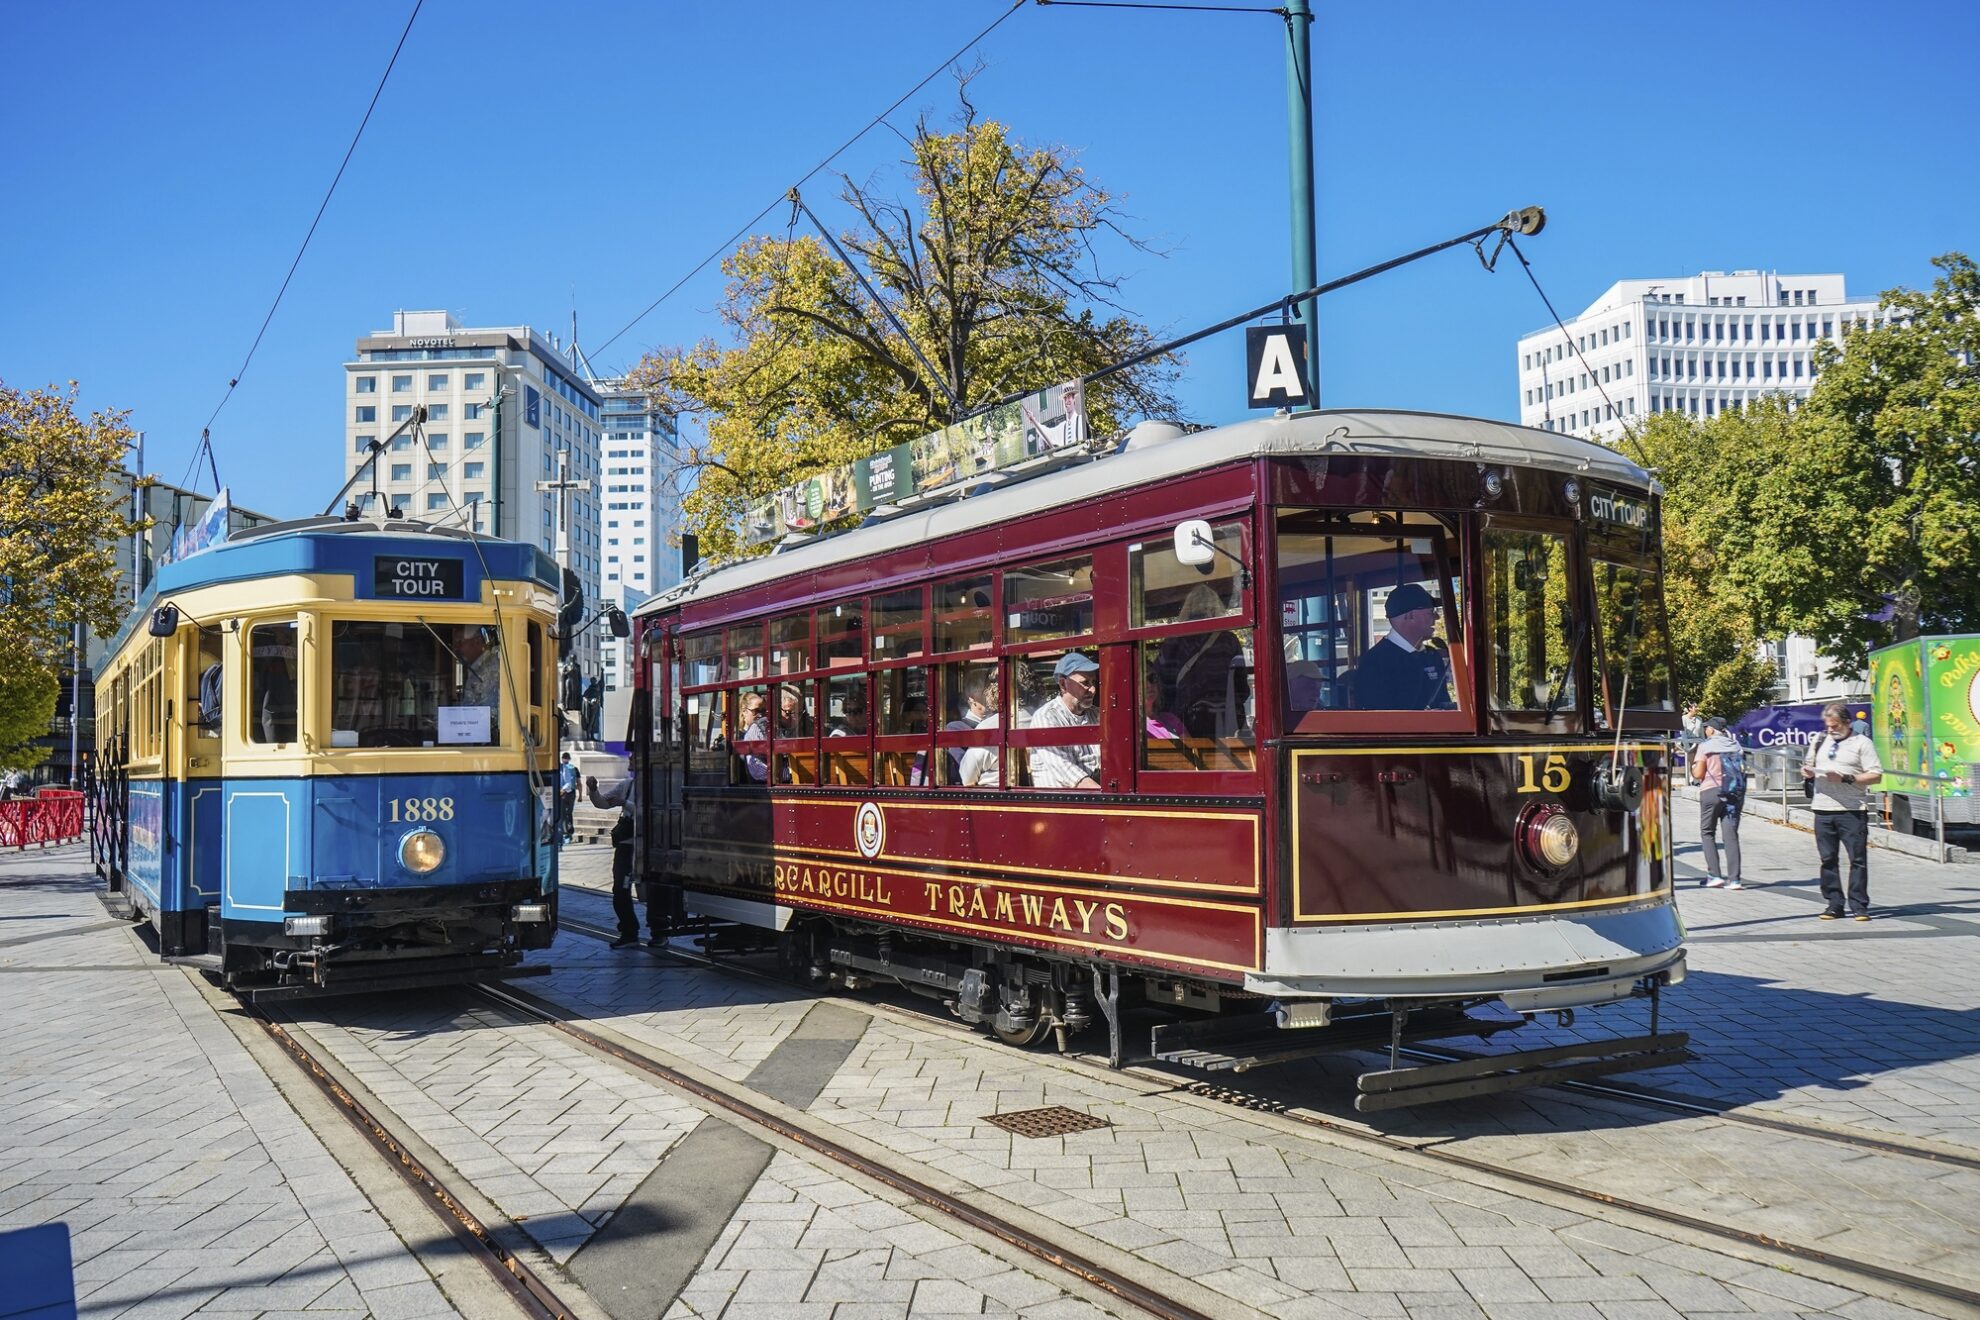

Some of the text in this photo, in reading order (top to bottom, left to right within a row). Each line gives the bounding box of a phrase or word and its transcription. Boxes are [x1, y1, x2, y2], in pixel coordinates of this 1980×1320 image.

[410, 338, 455, 346] NOVOTEL
[1253, 334, 1304, 399] A
[869, 469, 895, 487] PUNTING
[1591, 495, 1647, 527] CITY TOUR
[396, 561, 439, 577] CITY
[391, 579, 444, 595] TOUR
[1517, 755, 1571, 792] 15
[388, 797, 455, 823] 1888
[924, 883, 1129, 941] TRAMWAYS
